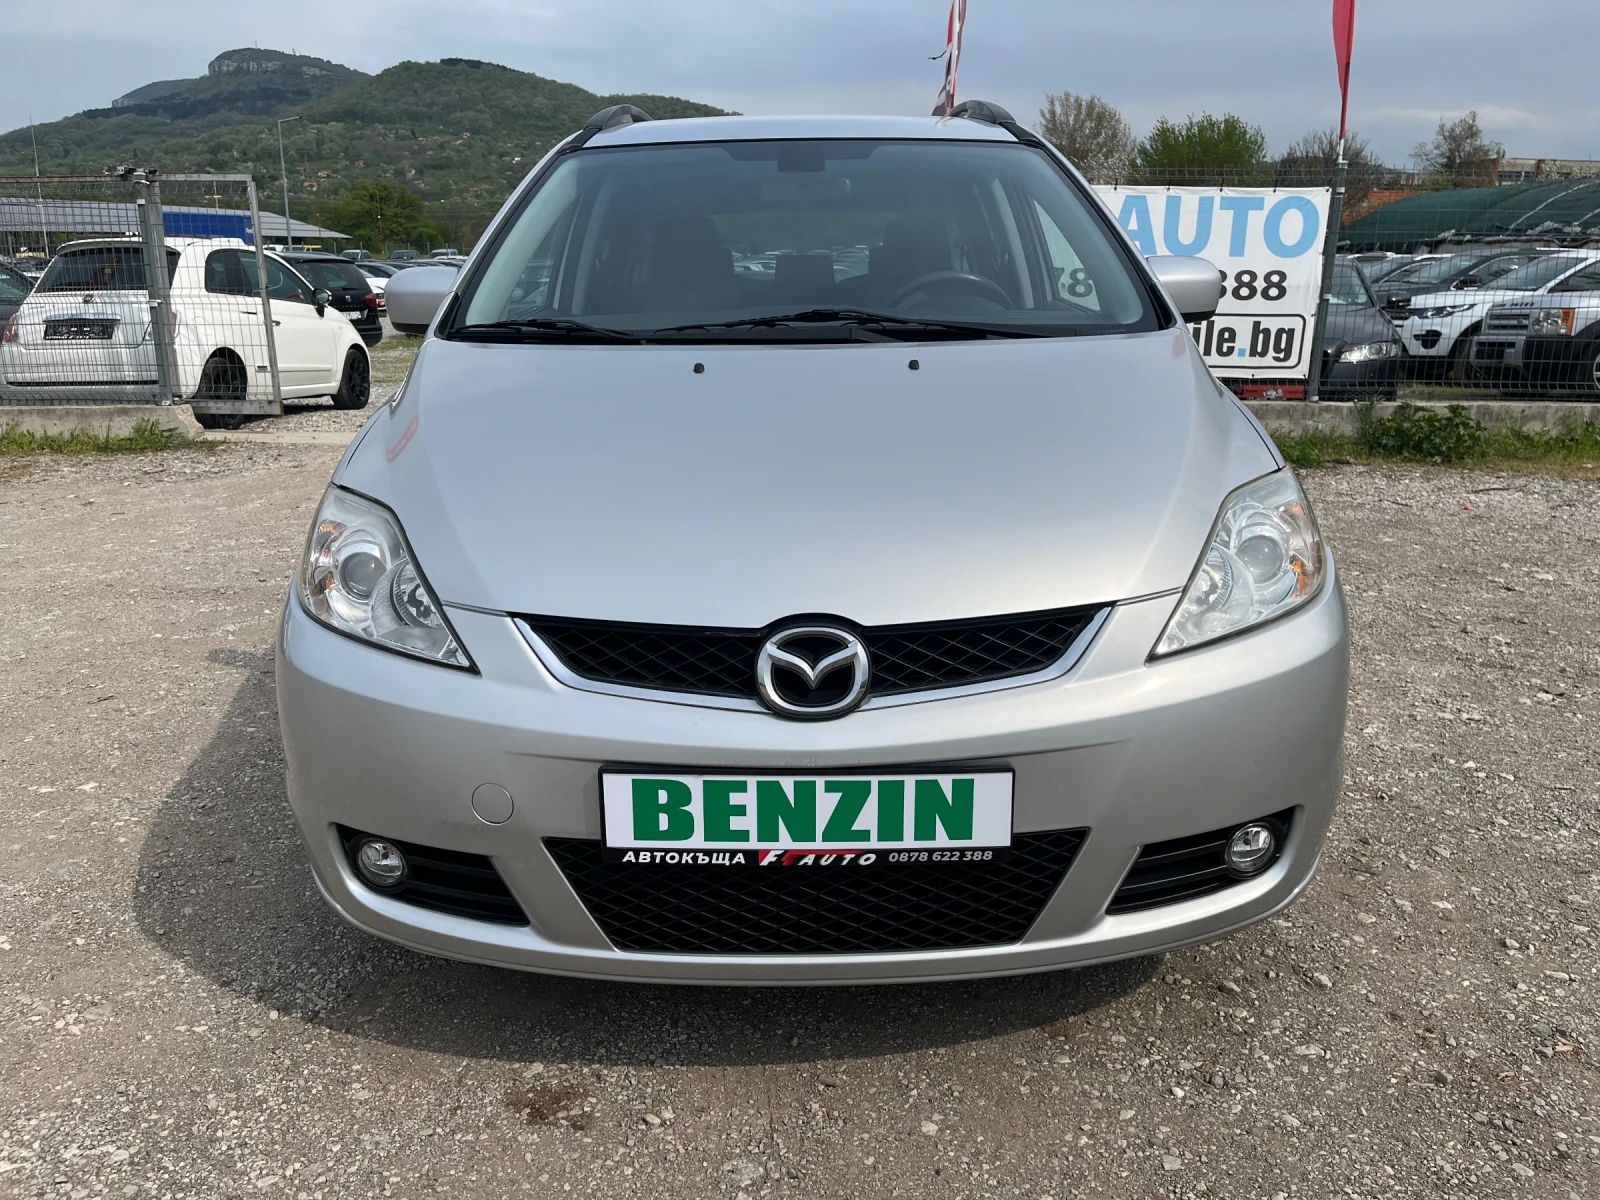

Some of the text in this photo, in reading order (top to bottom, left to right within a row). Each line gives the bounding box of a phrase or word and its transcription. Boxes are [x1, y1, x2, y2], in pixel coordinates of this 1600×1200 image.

[1117, 195, 1320, 258] AUTO
[632, 778, 974, 843] BENZIN
[622, 851, 746, 866] АВТОКЪЩА
[797, 853, 877, 866] AUTO
[888, 851, 928, 862] 0878
[932, 851, 960, 862] 622
[963, 850, 993, 861] 388
